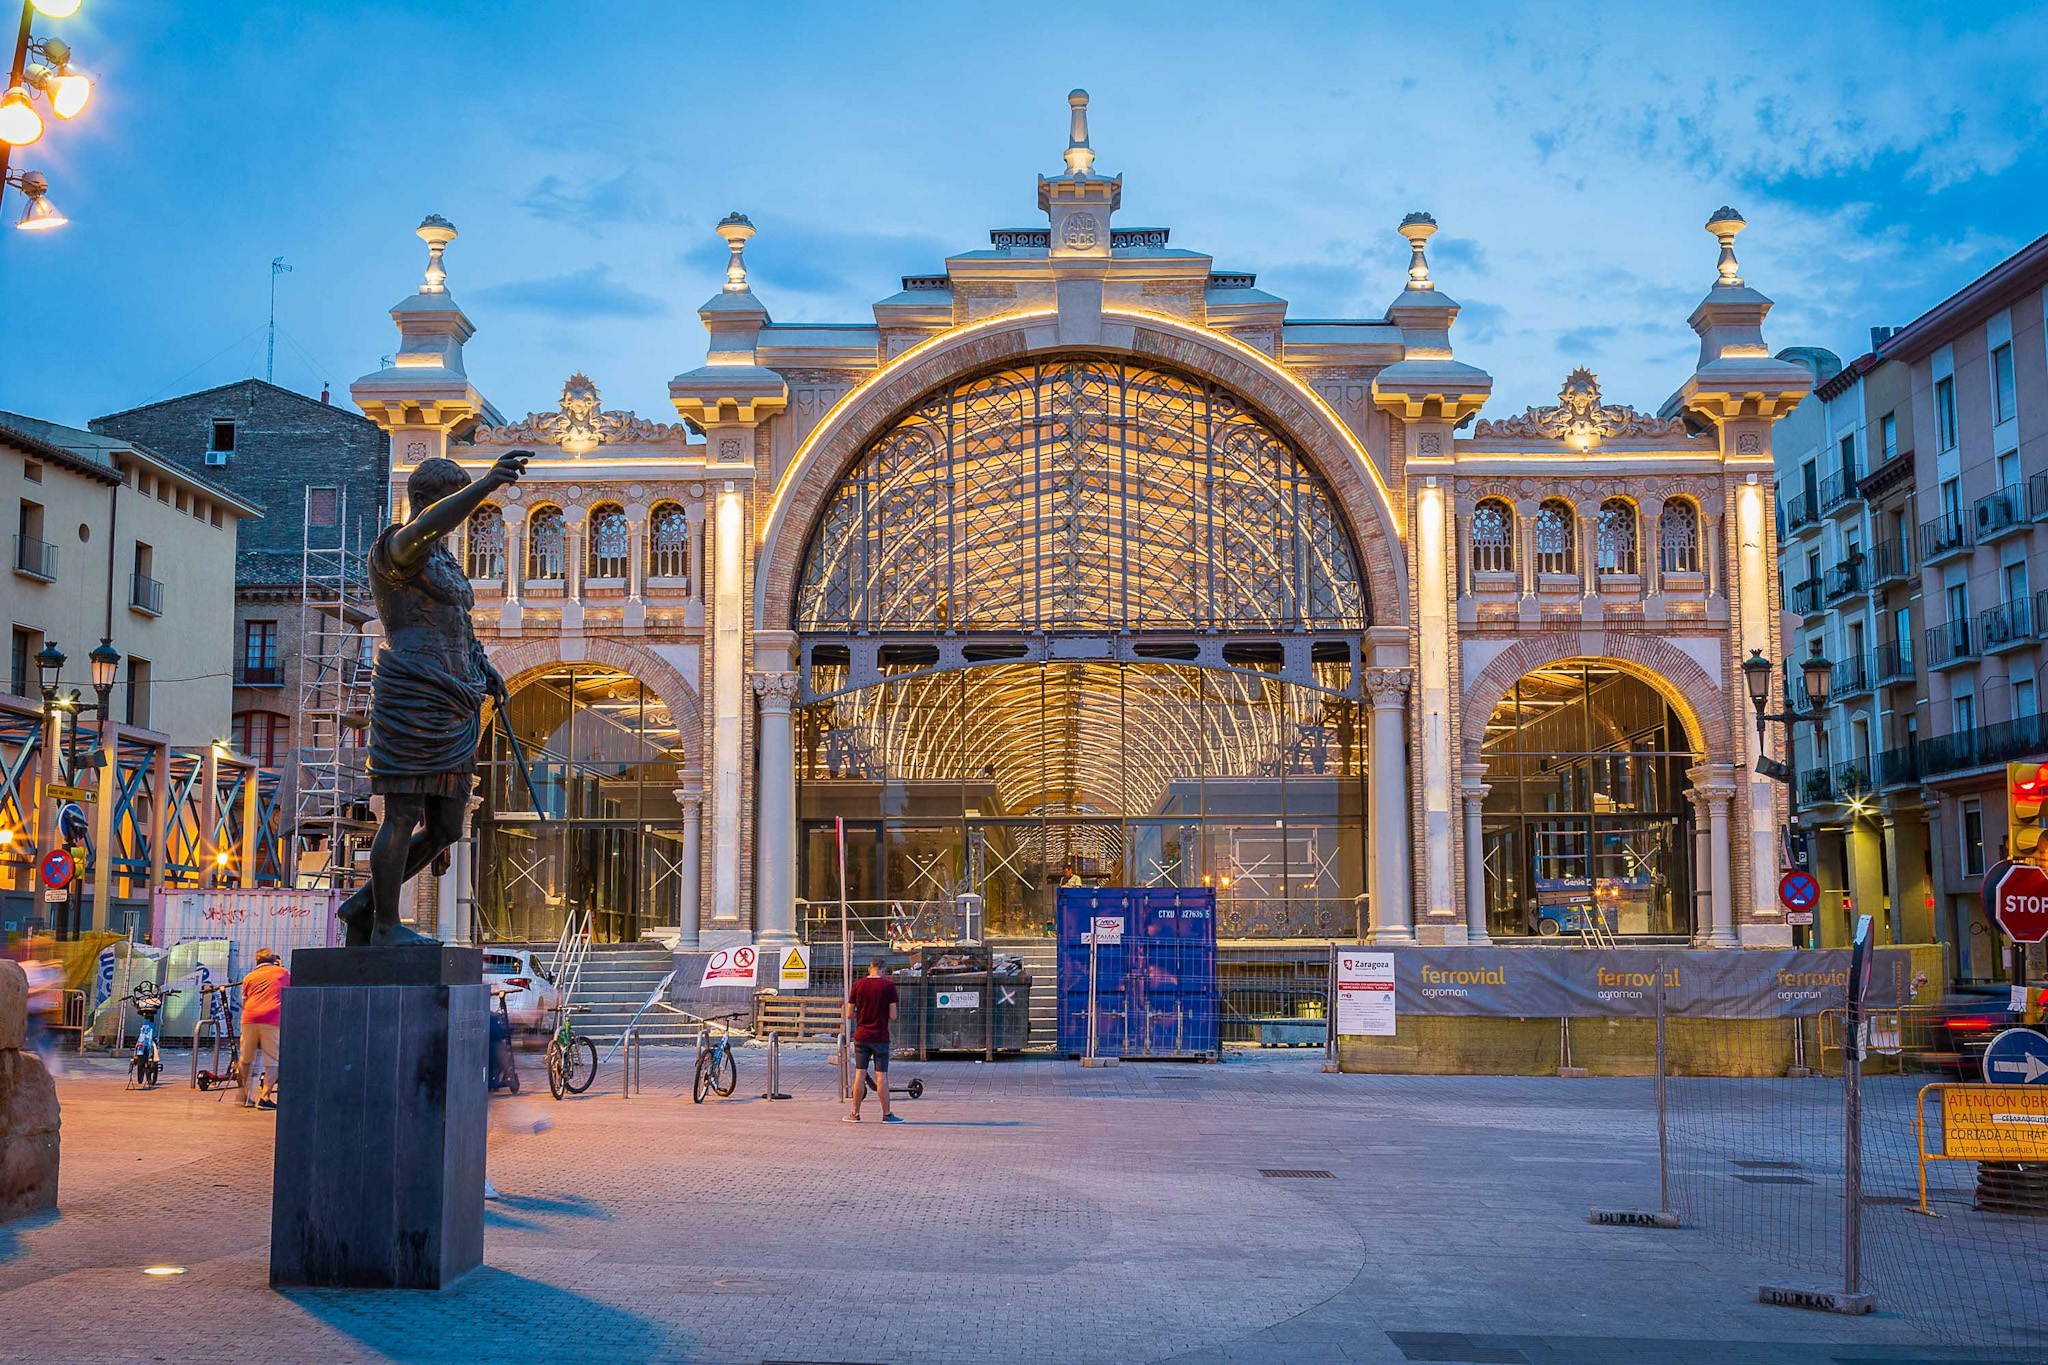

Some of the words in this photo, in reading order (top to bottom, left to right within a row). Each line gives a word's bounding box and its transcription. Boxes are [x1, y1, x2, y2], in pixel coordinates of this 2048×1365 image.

[1067, 216, 1094, 231] AÑO
[2005, 895, 2048, 914] STOP
[1158, 910, 1175, 918] CTXU
[1354, 960, 1389, 971] Zaragoza
[1421, 965, 1507, 985] ferrovial
[1596, 967, 1681, 987] ferroval
[1422, 988, 1468, 998] agroman
[1597, 991, 1643, 1000] agroman
[1777, 991, 1822, 1001] agroman
[1949, 1092, 2016, 1108] ATENCIÓN
[1954, 1113, 1986, 1124] CALLE
[1950, 1128, 2002, 1140] CORTADA
[2004, 1129, 2017, 1140] AL
